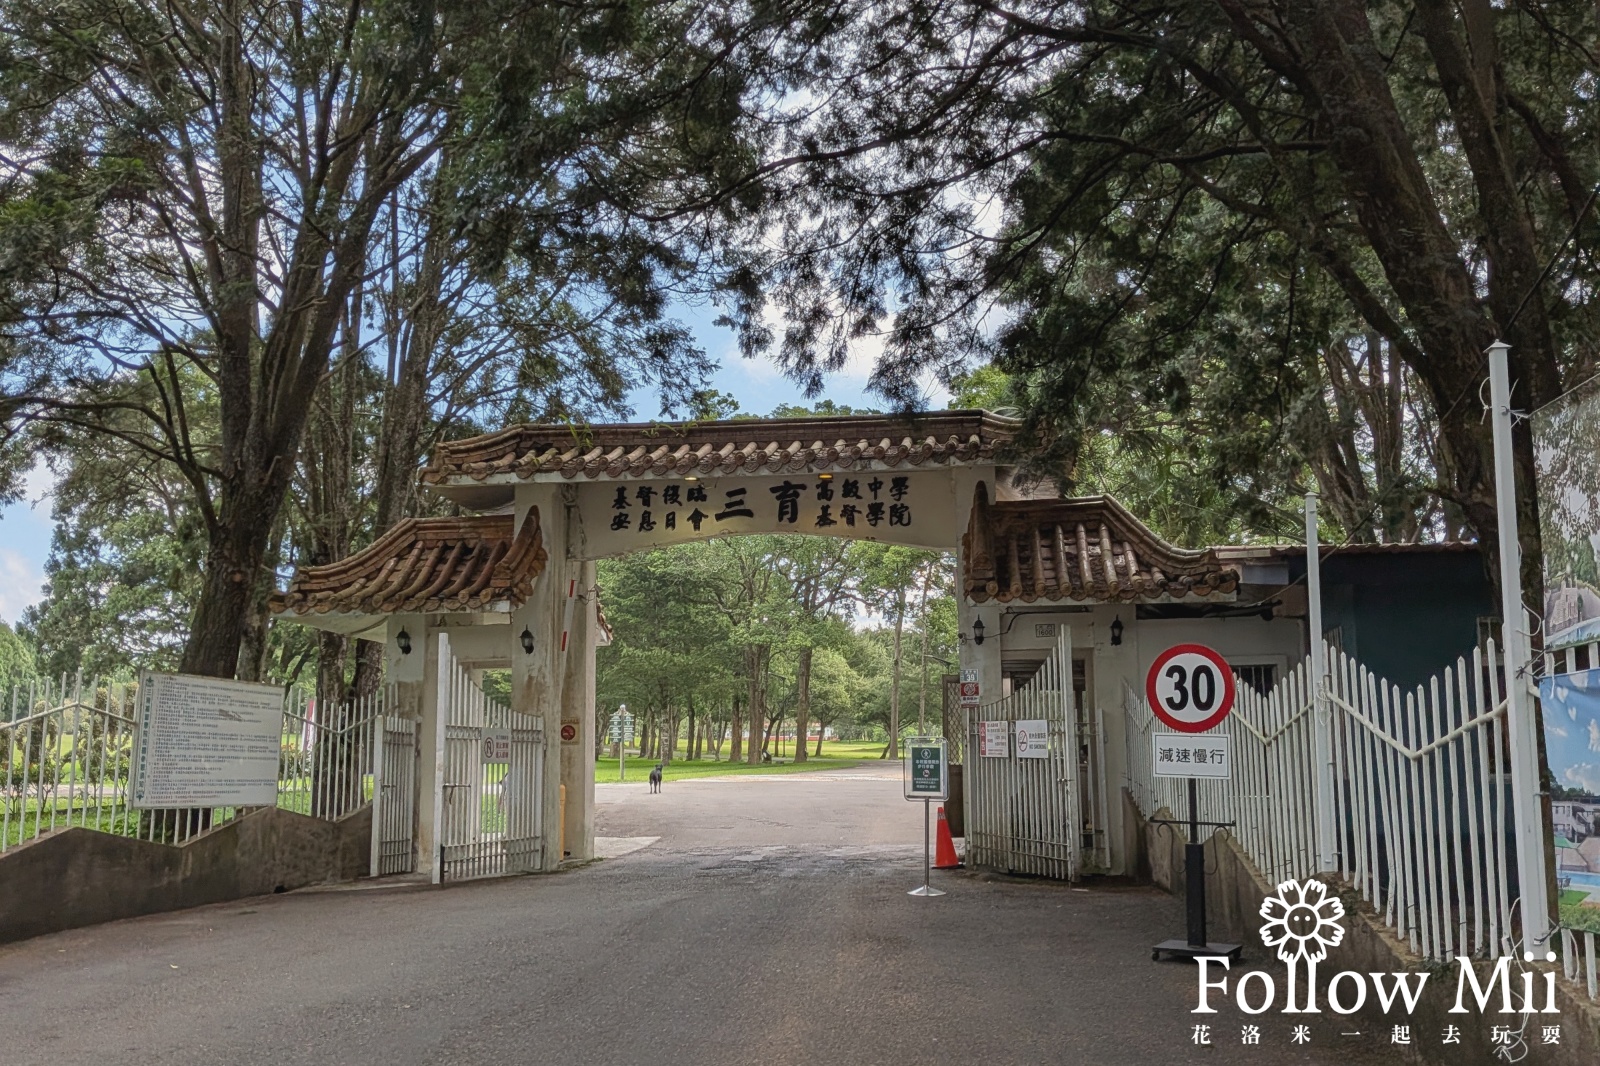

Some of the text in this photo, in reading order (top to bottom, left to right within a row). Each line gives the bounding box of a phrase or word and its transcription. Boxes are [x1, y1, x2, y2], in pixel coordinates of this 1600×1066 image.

[611, 484, 709, 509] 基督復臨
[714, 480, 808, 524] 三育
[815, 476, 910, 502] 高級中學
[610, 508, 709, 532] 安息日會
[815, 501, 912, 528] 基督學院
[1165, 664, 1216, 711] 30
[1159, 747, 1225, 765] 減速慢行
